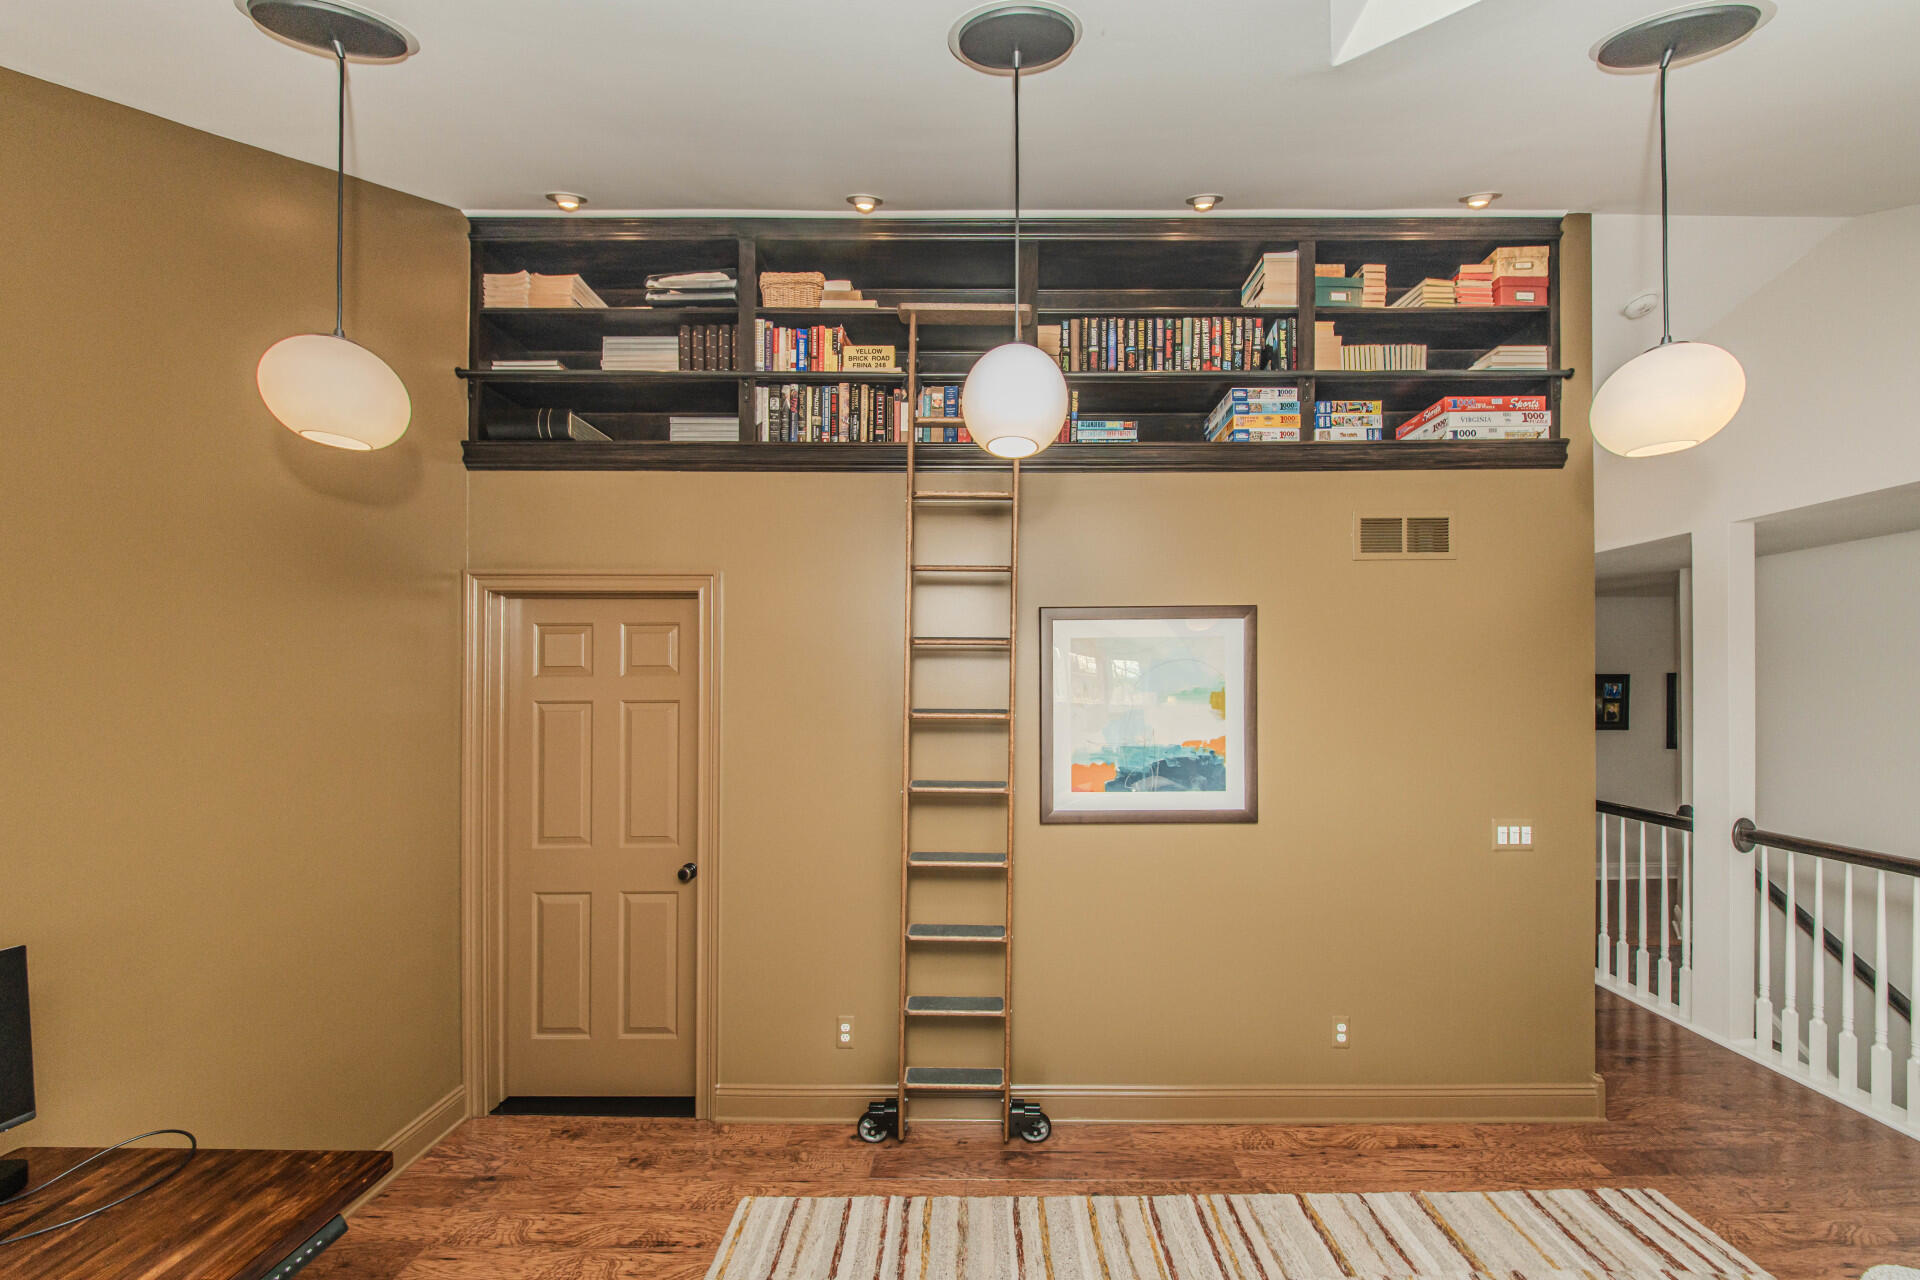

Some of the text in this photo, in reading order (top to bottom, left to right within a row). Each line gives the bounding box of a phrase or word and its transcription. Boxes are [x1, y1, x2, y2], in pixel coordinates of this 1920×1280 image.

[1448, 399, 1476, 409] 1000
[1510, 398, 1539, 410] Sports
[1522, 413, 1544, 422] 1000
[1449, 430, 1476, 440] 1000
